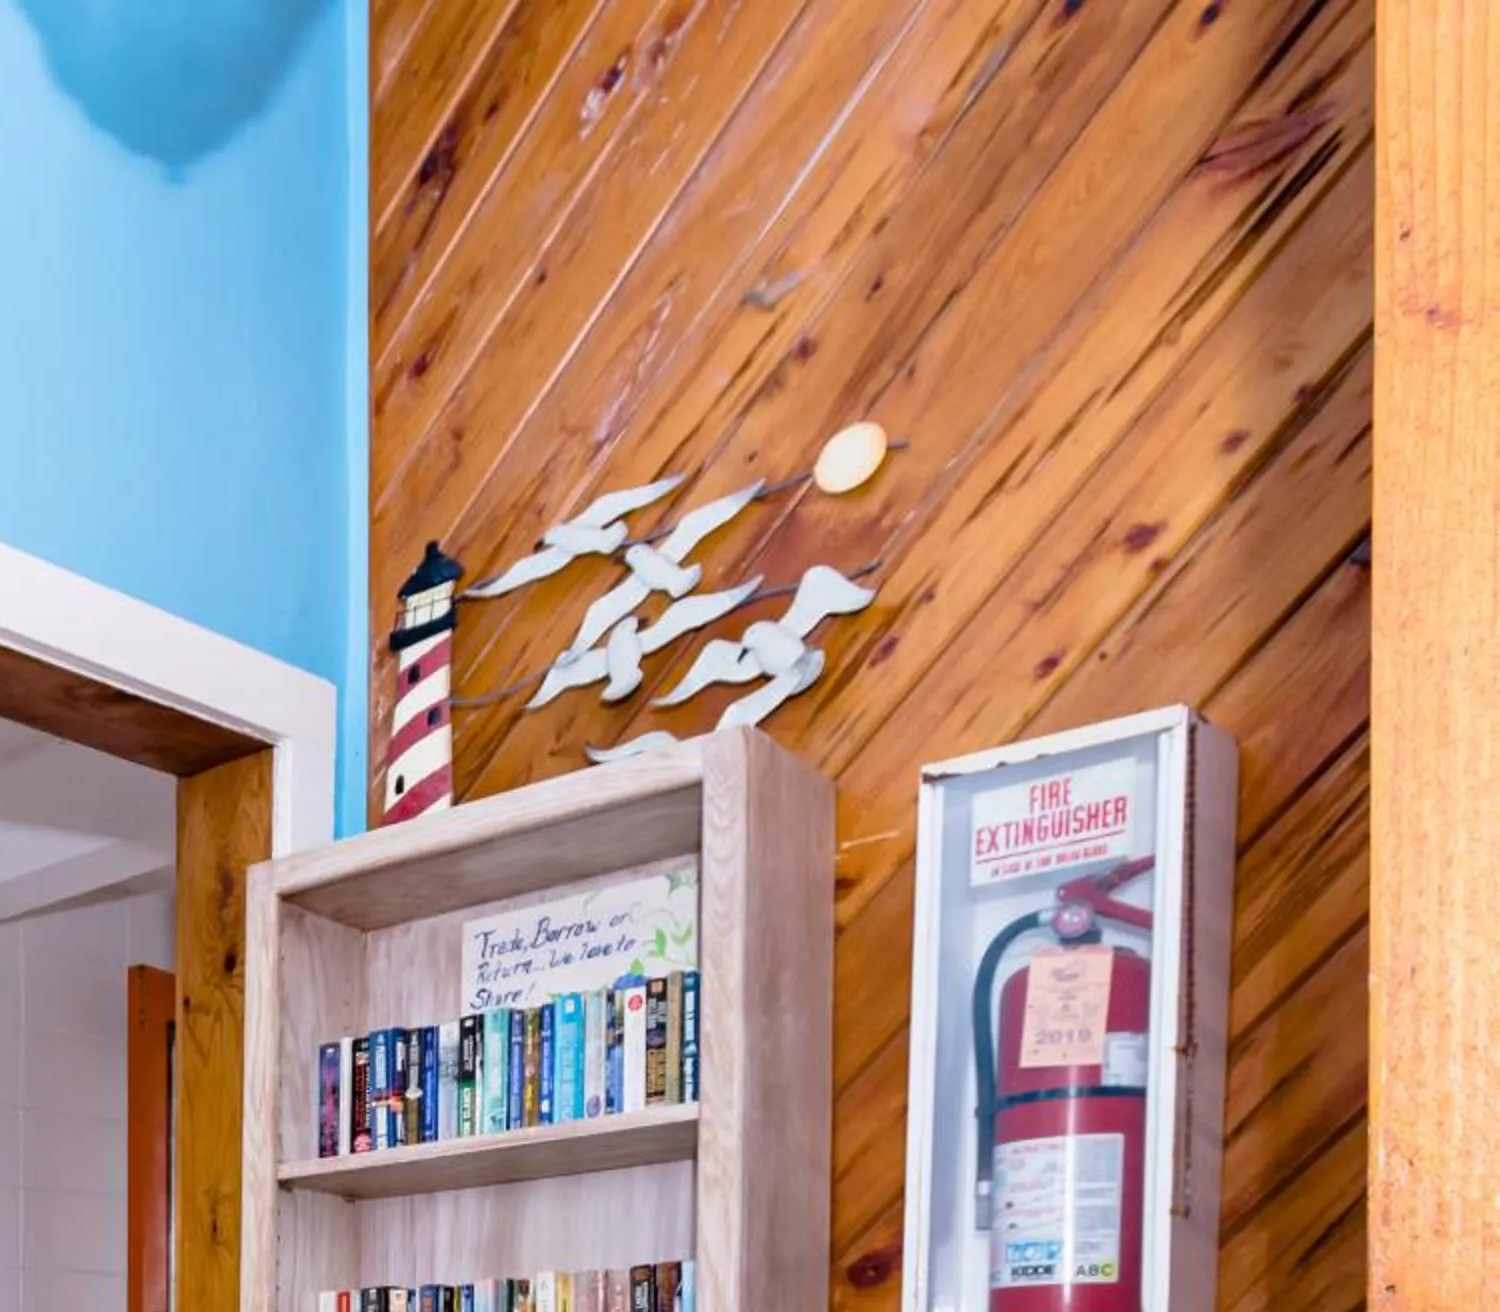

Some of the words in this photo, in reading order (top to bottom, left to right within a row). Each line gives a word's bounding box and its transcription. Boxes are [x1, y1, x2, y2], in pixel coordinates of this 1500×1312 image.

[1029, 776, 1072, 813] FIRE
[975, 796, 1127, 857] EXTINGUISHER
[530, 917, 600, 949] Borrow
[609, 912, 628, 928] or
[616, 934, 636, 952] to
[1076, 1263, 1114, 1277] ABC
